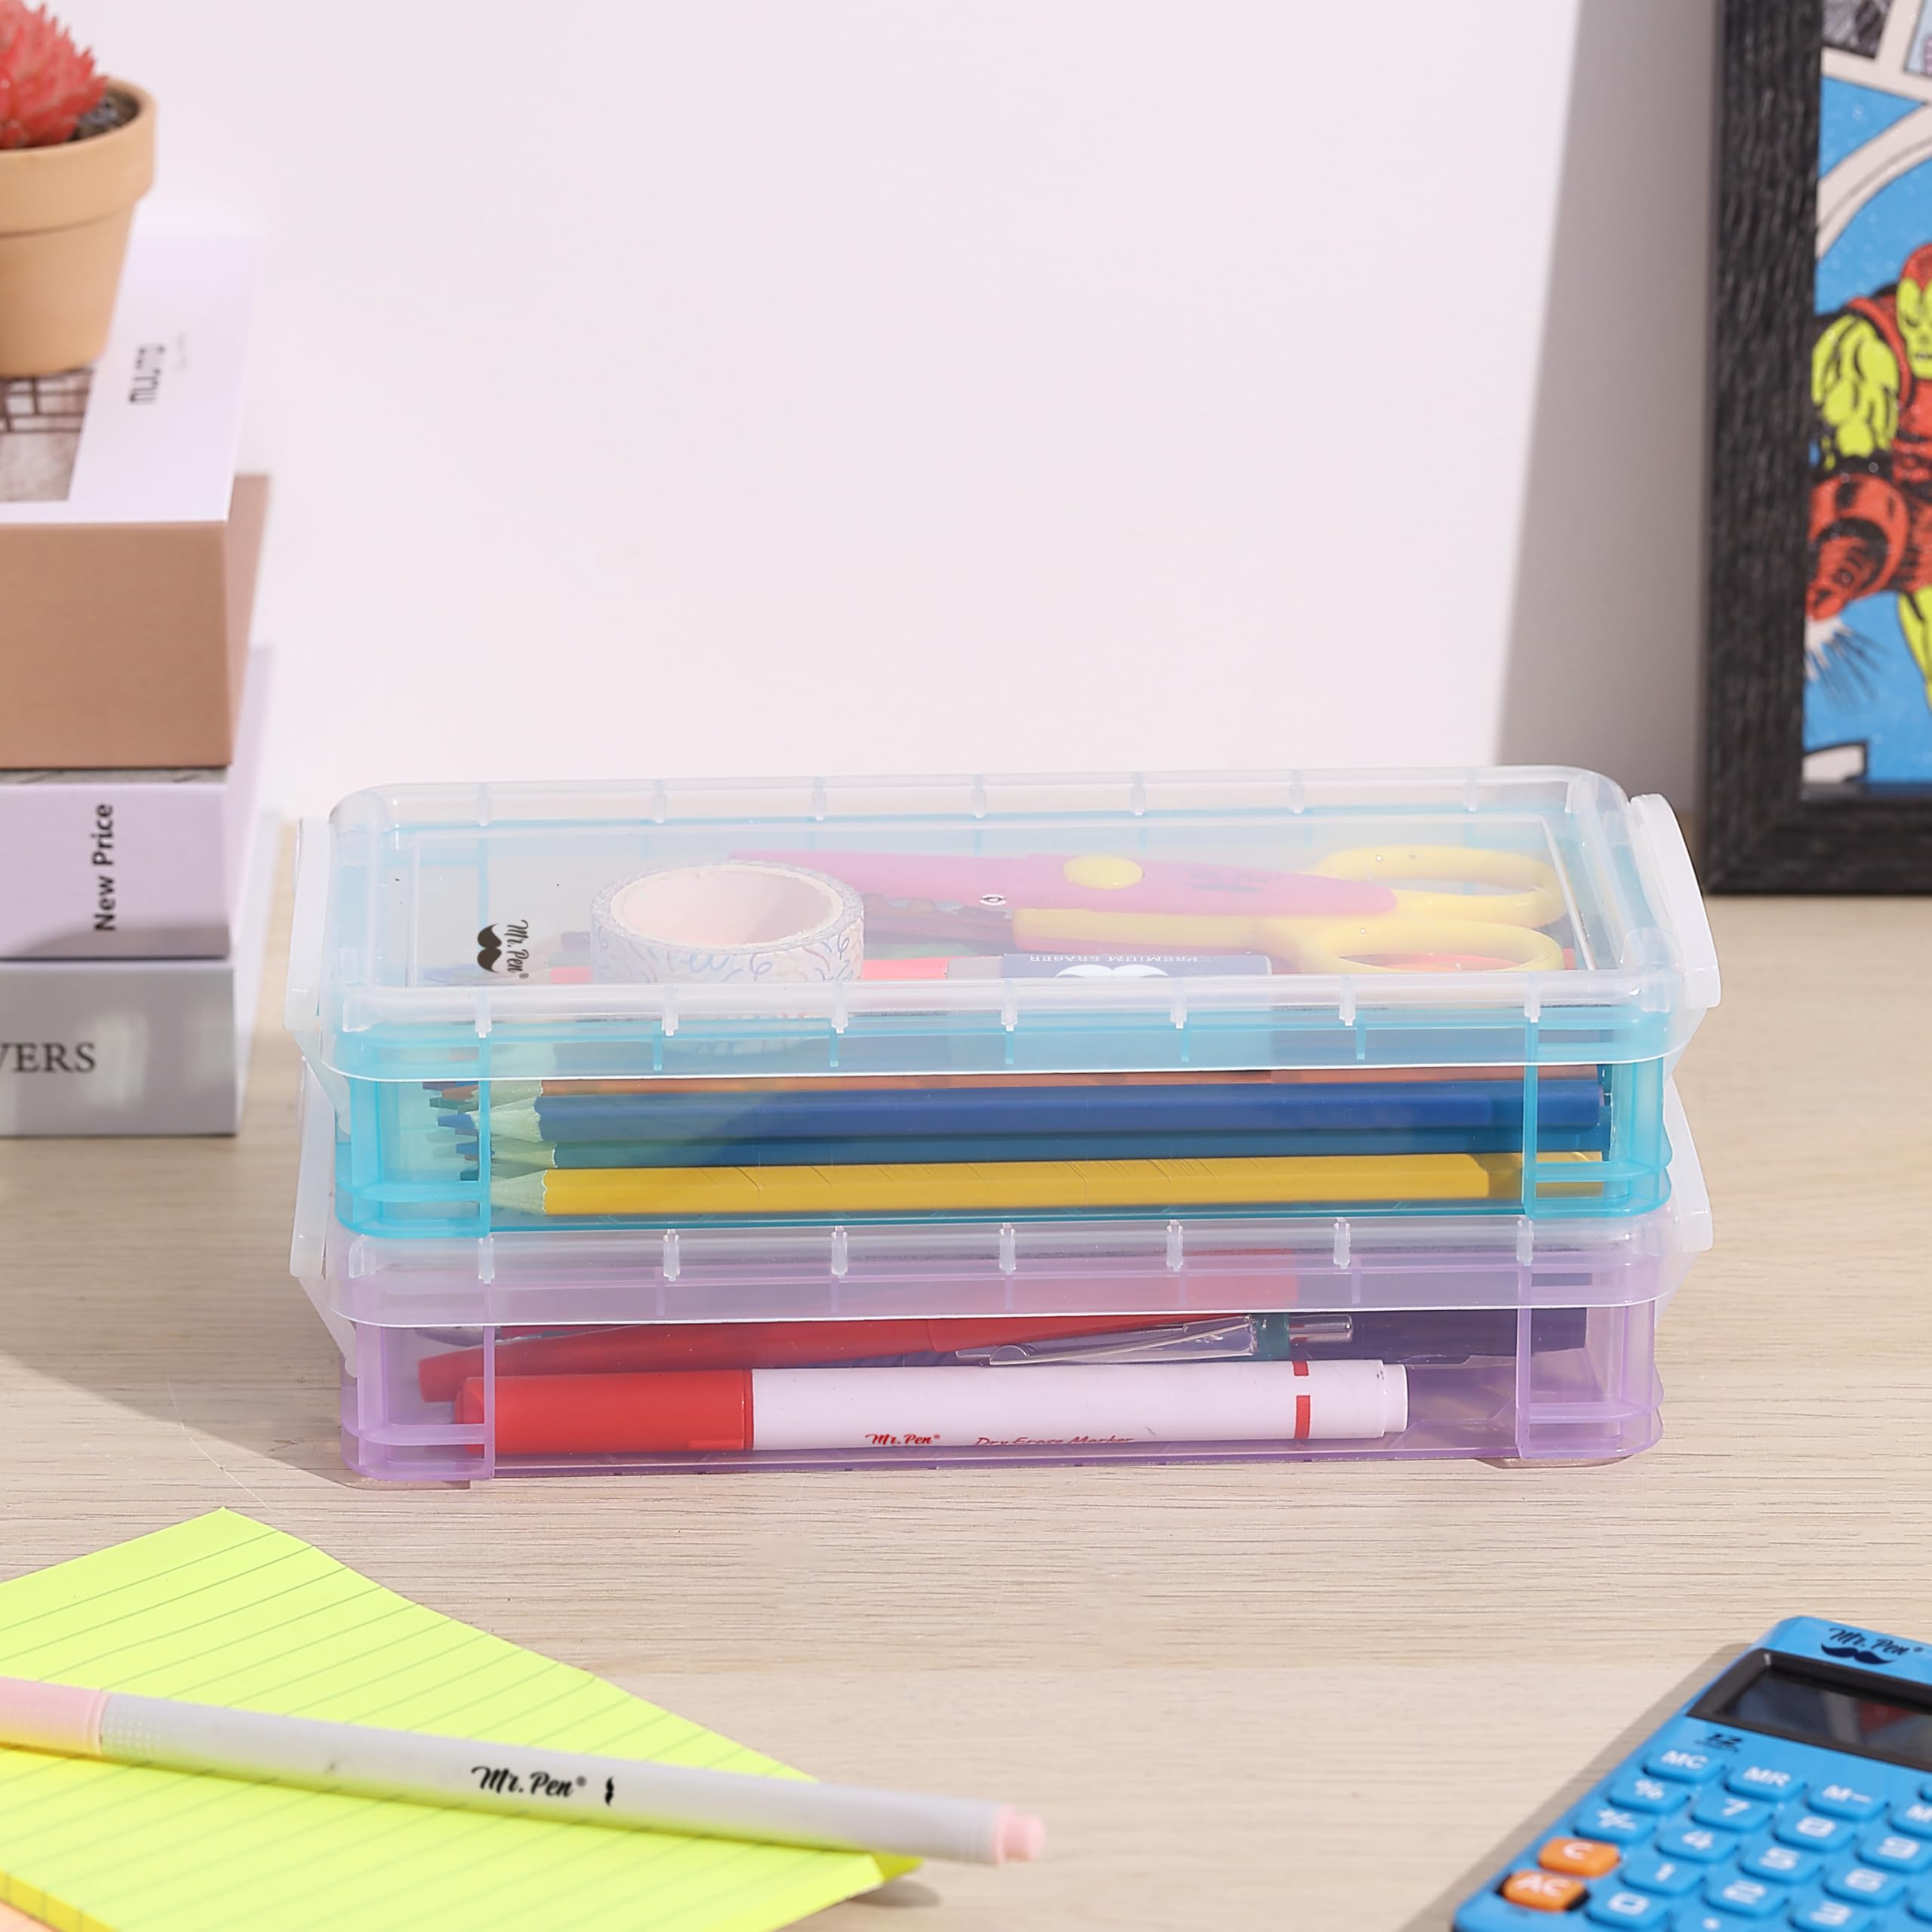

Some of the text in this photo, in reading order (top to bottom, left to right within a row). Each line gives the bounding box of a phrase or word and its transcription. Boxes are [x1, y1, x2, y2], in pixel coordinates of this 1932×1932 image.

[91, 803, 115, 932] New Price
[504, 918, 529, 947] Mr.
[865, 1433, 900, 1445] Mr.
[1829, 1627, 1866, 1647] Mr.
[1661, 1749, 1709, 1770] MC
[470, 1765, 525, 1794] Mr.
[1742, 1766, 1791, 1788] MR
[1721, 1797, 1751, 1817] 7
[1681, 1829, 1715, 1850] 4
[1562, 1841, 1595, 1860] C
[1655, 1862, 1677, 1882] 1
[1515, 1873, 1571, 1899] AC
[1607, 1891, 1651, 1916] 0
